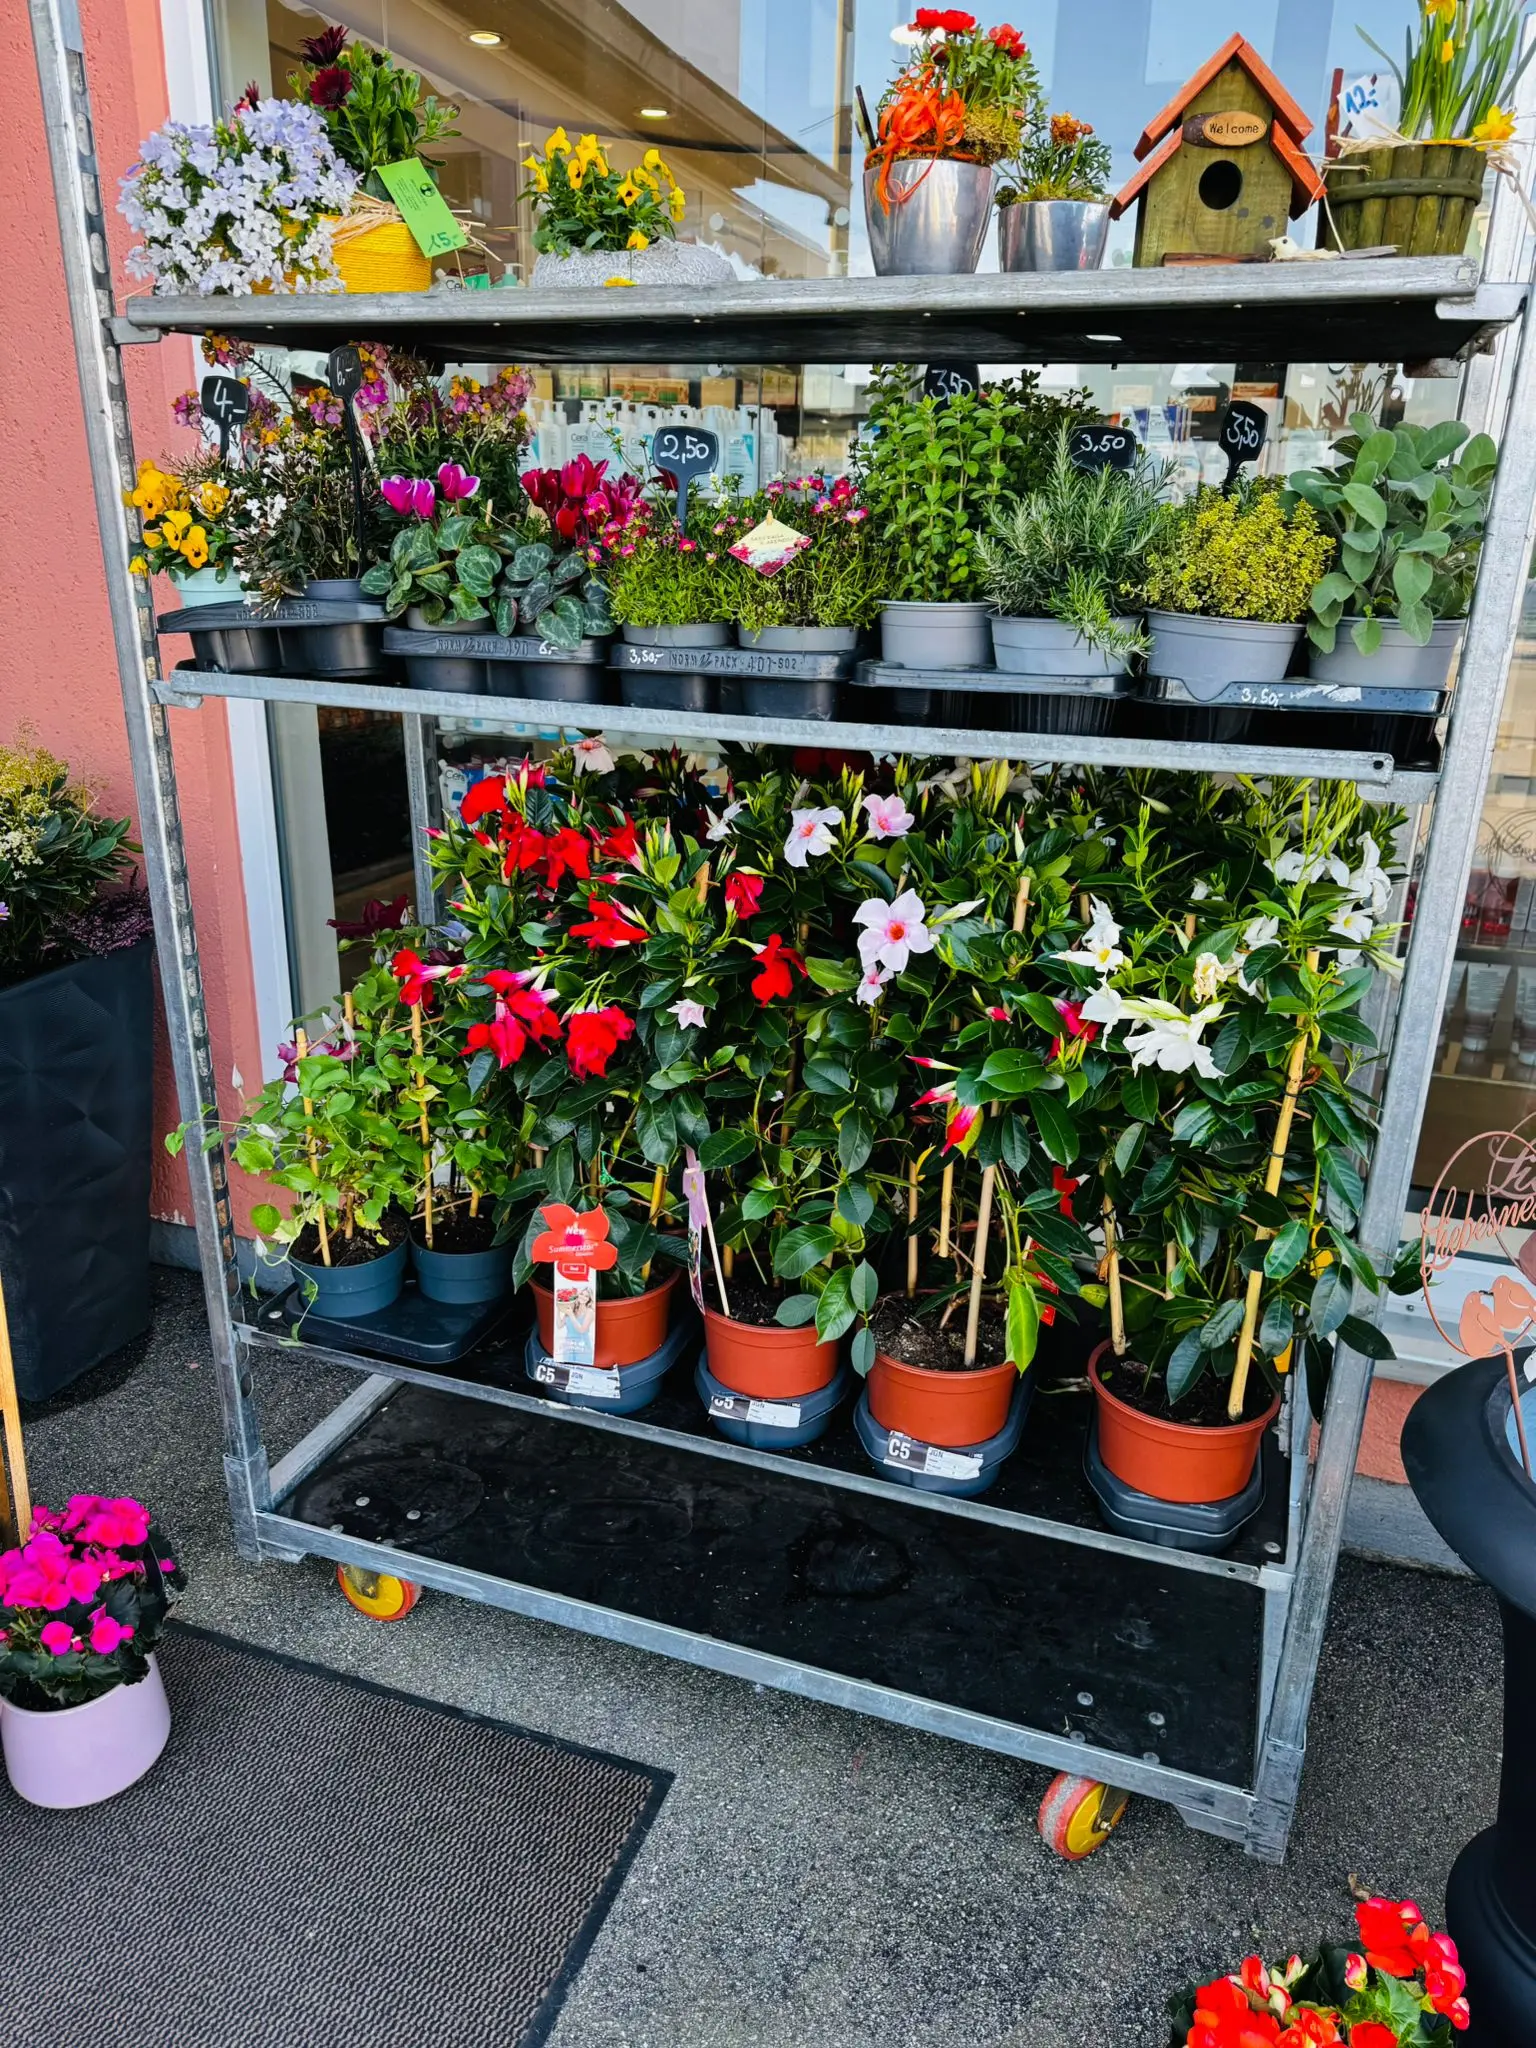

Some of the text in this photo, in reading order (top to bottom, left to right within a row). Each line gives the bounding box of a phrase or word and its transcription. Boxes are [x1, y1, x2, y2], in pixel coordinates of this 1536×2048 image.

[1209, 122, 1260, 135] Welcome
[213, 378, 247, 422] 4,-
[1226, 411, 1260, 450] 3,50
[659, 434, 710, 464] 2,50
[1079, 433, 1126, 453] 3,50
[671, 652, 698, 668] NORM
[536, 1364, 556, 1384] C5
[888, 1438, 912, 1460] C5
